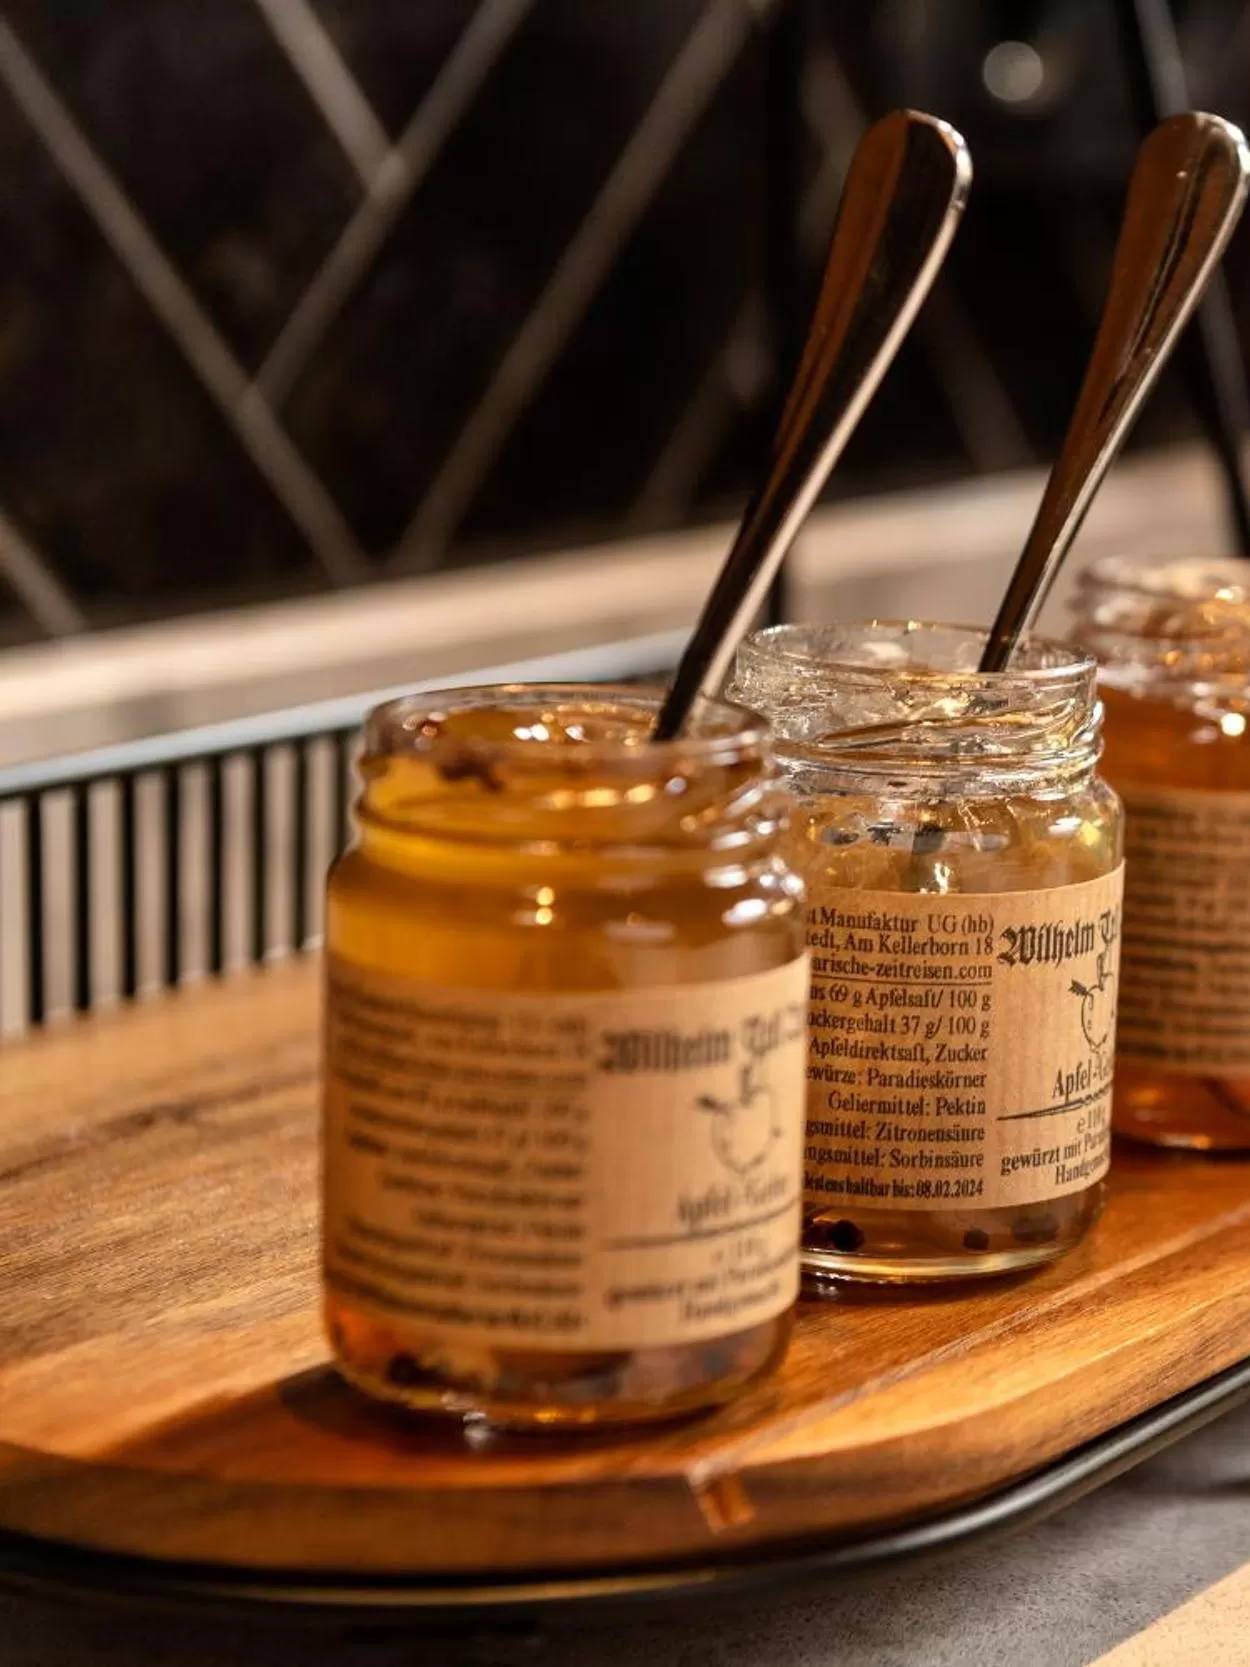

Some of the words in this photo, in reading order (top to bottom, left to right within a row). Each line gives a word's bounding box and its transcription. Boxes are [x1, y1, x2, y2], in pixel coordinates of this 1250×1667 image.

[820, 906, 919, 933] Manufaktur
[928, 914, 957, 934] UG
[961, 914, 995, 937] (hb)
[844, 932, 874, 953] Am
[879, 934, 970, 956] Kellerborn
[976, 935, 994, 956] 18
[996, 919, 1095, 970] Wilhelm
[811, 953, 993, 980] arische-zeitreisen.com
[852, 990, 862, 1008] g
[949, 988, 977, 1008] 100
[981, 994, 992, 1012] g
[807, 1008, 896, 1034] uckergehalt
[900, 1015, 921, 1035] 37
[948, 1016, 976, 1036] 100
[980, 1021, 990, 1039] g
[934, 1043, 987, 1063] Zucker
[806, 1065, 861, 1085] ewürze:
[867, 1067, 987, 1089] Paradieskörner
[828, 1089, 931, 1116] Geliermittel:
[935, 1096, 986, 1117] Pektin
[805, 1119, 871, 1140] gsmittel:
[875, 1121, 985, 1142] Zitronensäure
[804, 1145, 885, 1168] ngsmittel:
[889, 1148, 984, 1169] Sorbinsäure
[1000, 1146, 1061, 1176] gewürzt
[1063, 1138, 1081, 1160] mit
